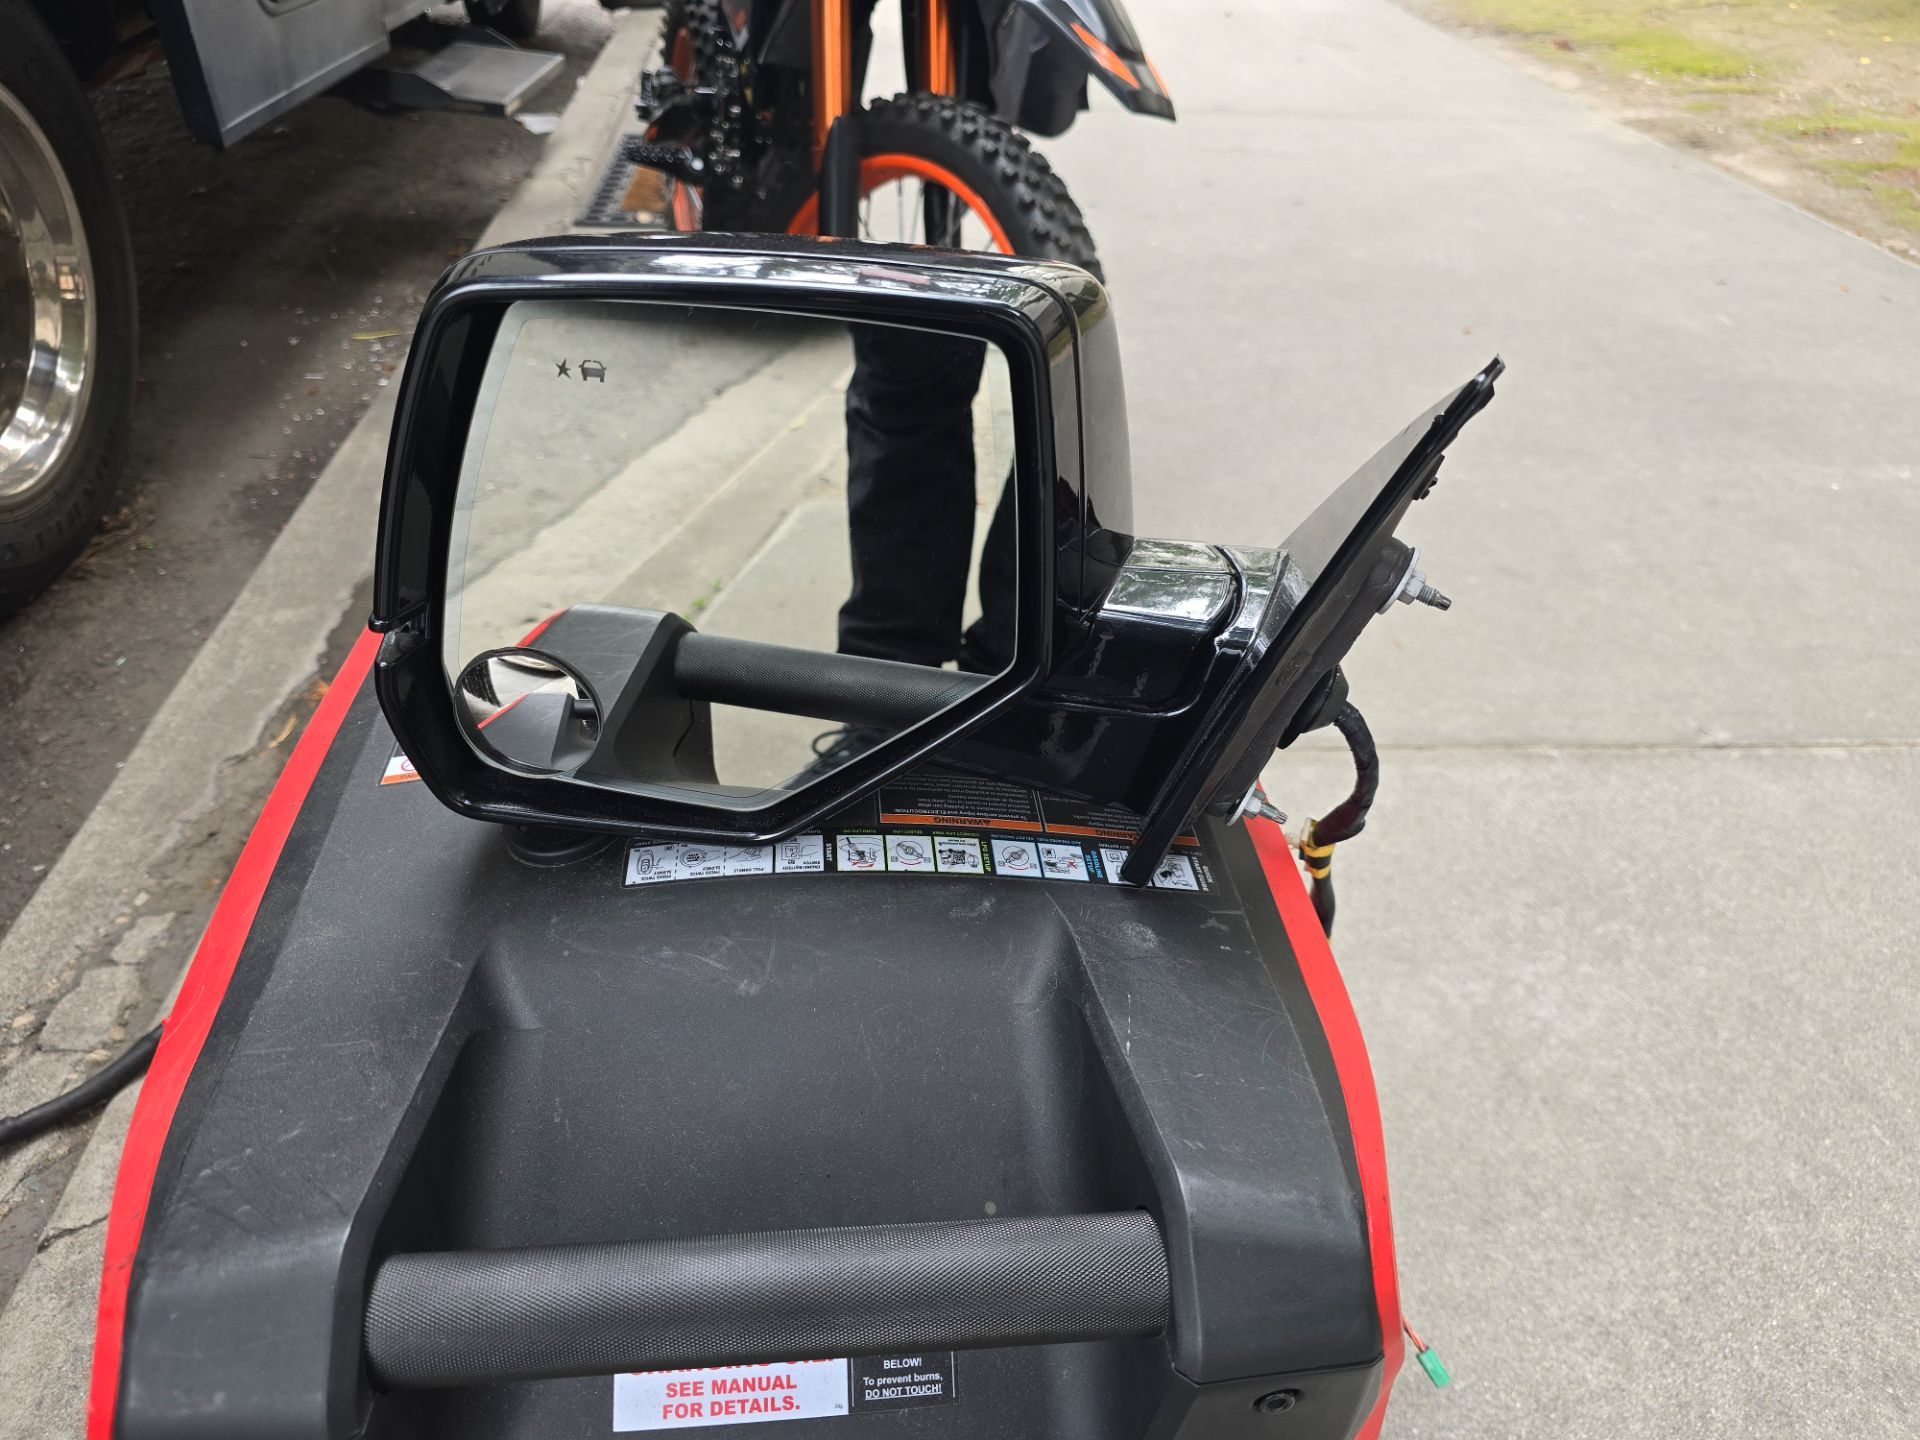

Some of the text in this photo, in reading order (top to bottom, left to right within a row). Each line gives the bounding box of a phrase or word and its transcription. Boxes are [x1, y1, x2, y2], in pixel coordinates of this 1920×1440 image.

[933, 817, 983, 826] WARNING
[981, 852, 991, 872] SETUP
[1192, 856, 1203, 873] START
[1198, 874, 1209, 892] GUIDE
[883, 1357, 922, 1369] BELOW!
[665, 1374, 797, 1399] SEE MANUAL
[863, 1372, 943, 1387] To prevent burns,
[865, 1383, 942, 1399] DO NOT TOUCH!
[662, 1395, 800, 1420] FOR DETAILS.
